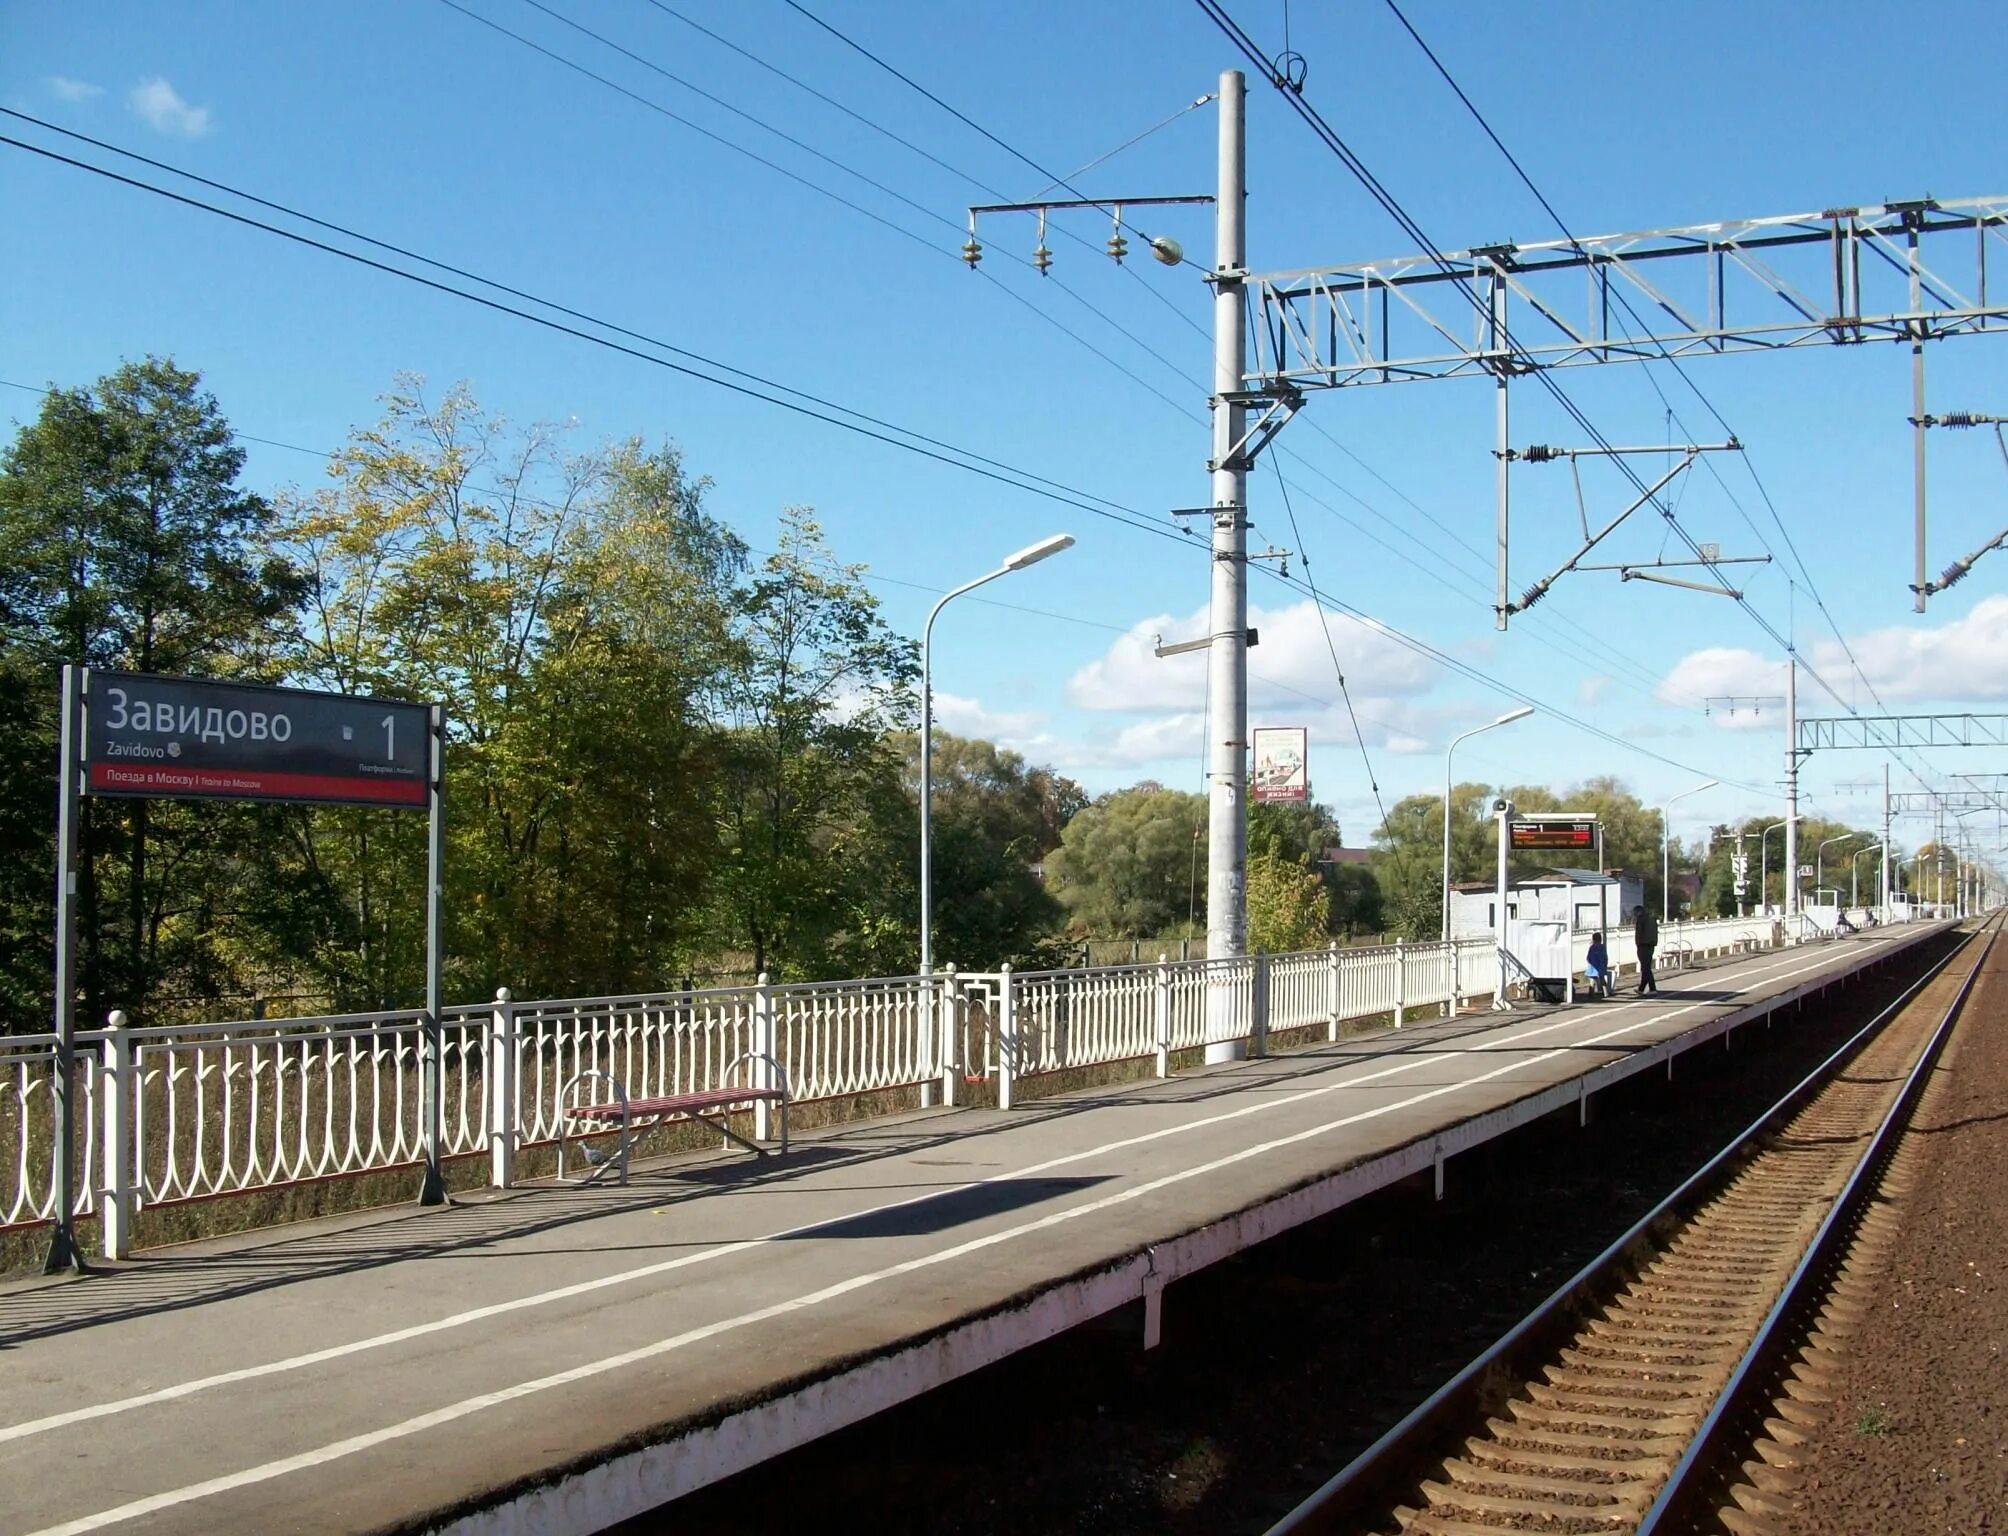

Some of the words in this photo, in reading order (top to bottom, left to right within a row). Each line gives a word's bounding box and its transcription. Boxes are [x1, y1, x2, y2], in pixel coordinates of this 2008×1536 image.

[106, 687, 292, 744] Завидово
[107, 741, 165, 758] Zavidovo
[381, 714, 395, 761] 1
[106, 769, 145, 783] Поезда
[147, 773, 153, 783] в
[155, 772, 194, 787] Москву
